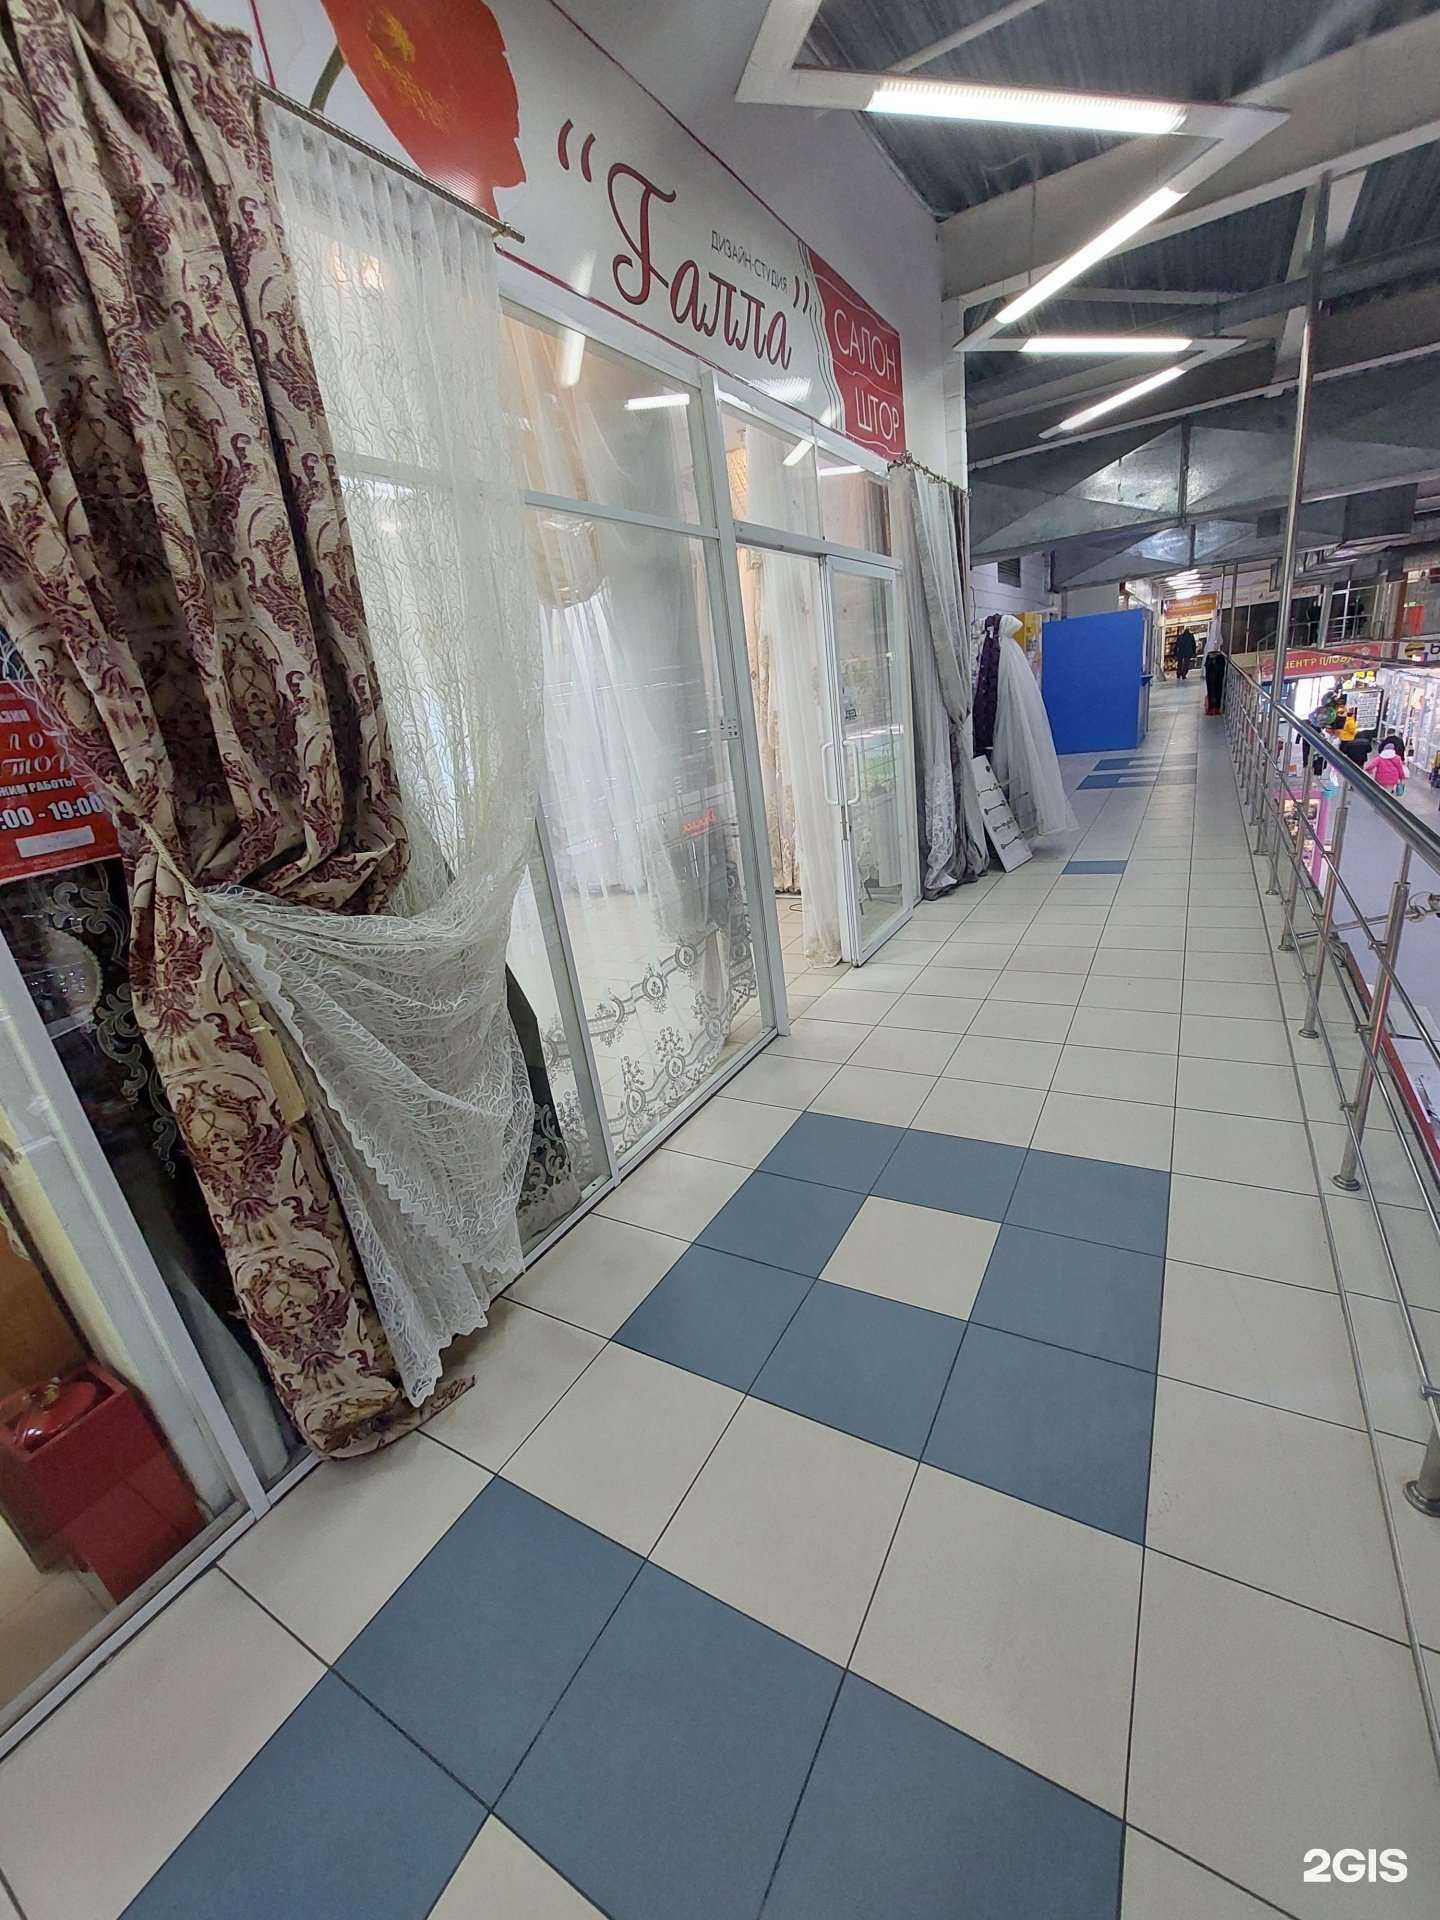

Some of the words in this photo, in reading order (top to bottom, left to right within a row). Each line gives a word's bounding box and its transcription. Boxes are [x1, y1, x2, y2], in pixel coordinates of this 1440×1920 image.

[710, 229, 789, 292] ДИЗАЙН-СТУДИЯ
[833, 308, 897, 385] САЛОН
[853, 386, 901, 441] ШТОР
[28, 777, 77, 794] РАБОТЫ
[47, 793, 104, 821] 19:00
